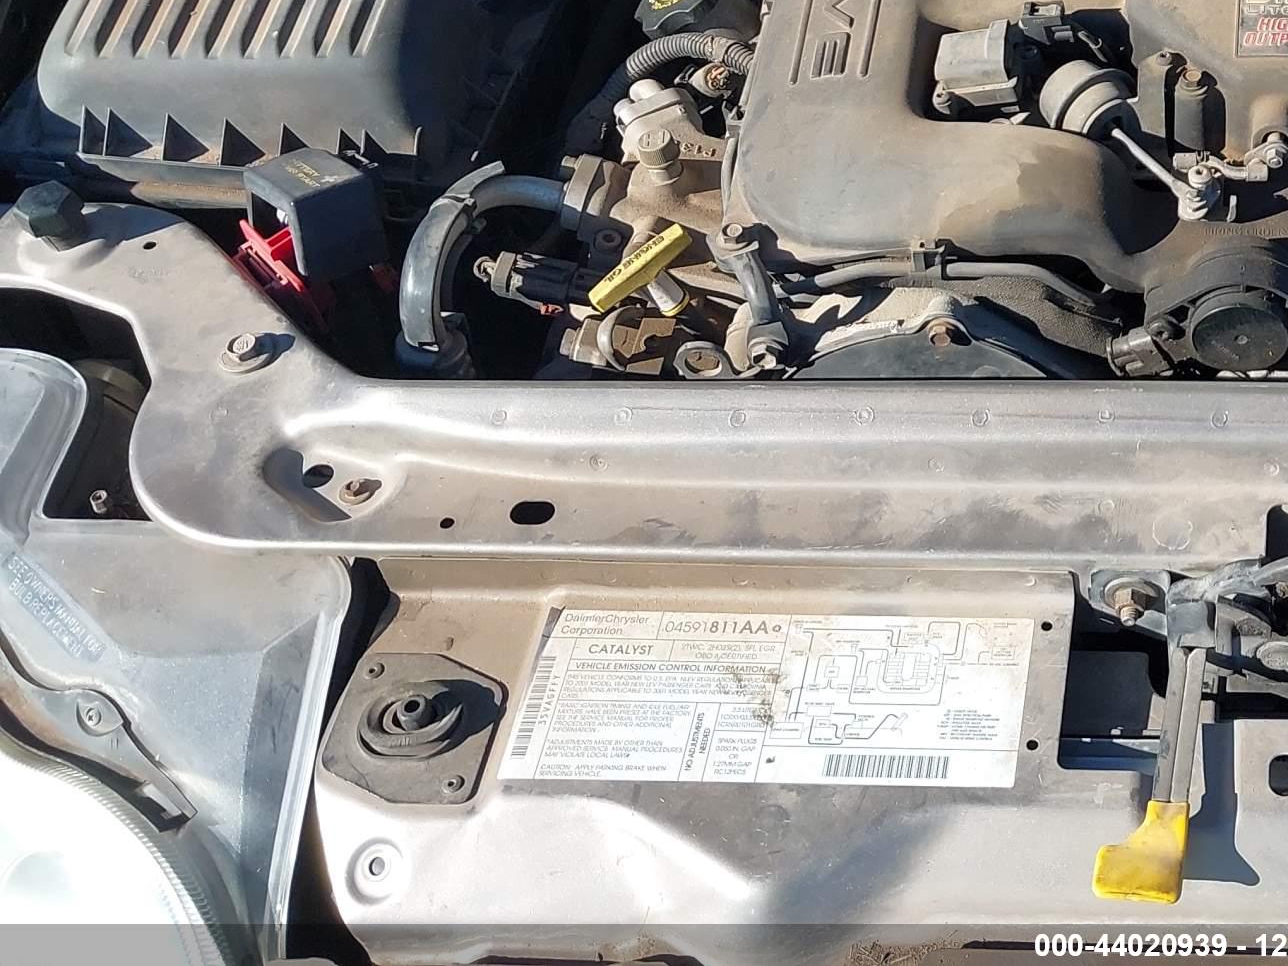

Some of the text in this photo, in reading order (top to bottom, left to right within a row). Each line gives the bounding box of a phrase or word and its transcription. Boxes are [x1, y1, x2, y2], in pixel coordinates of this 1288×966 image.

[604, 236, 665, 283] ENGINE OIL
[8, 556, 28, 577] SEE
[24, 571, 57, 611] OWNERS
[9, 579, 33, 604] BULB
[561, 626, 623, 636] Corporation
[564, 613, 650, 624] DaimlerChrysler
[588, 643, 653, 655] CATALYST
[575, 661, 766, 673] VEHICLE EMISSION CONTROL INFORMATION
[684, 712, 705, 771] NO ADJUSTMENTS
[698, 727, 711, 754] NEEDED
